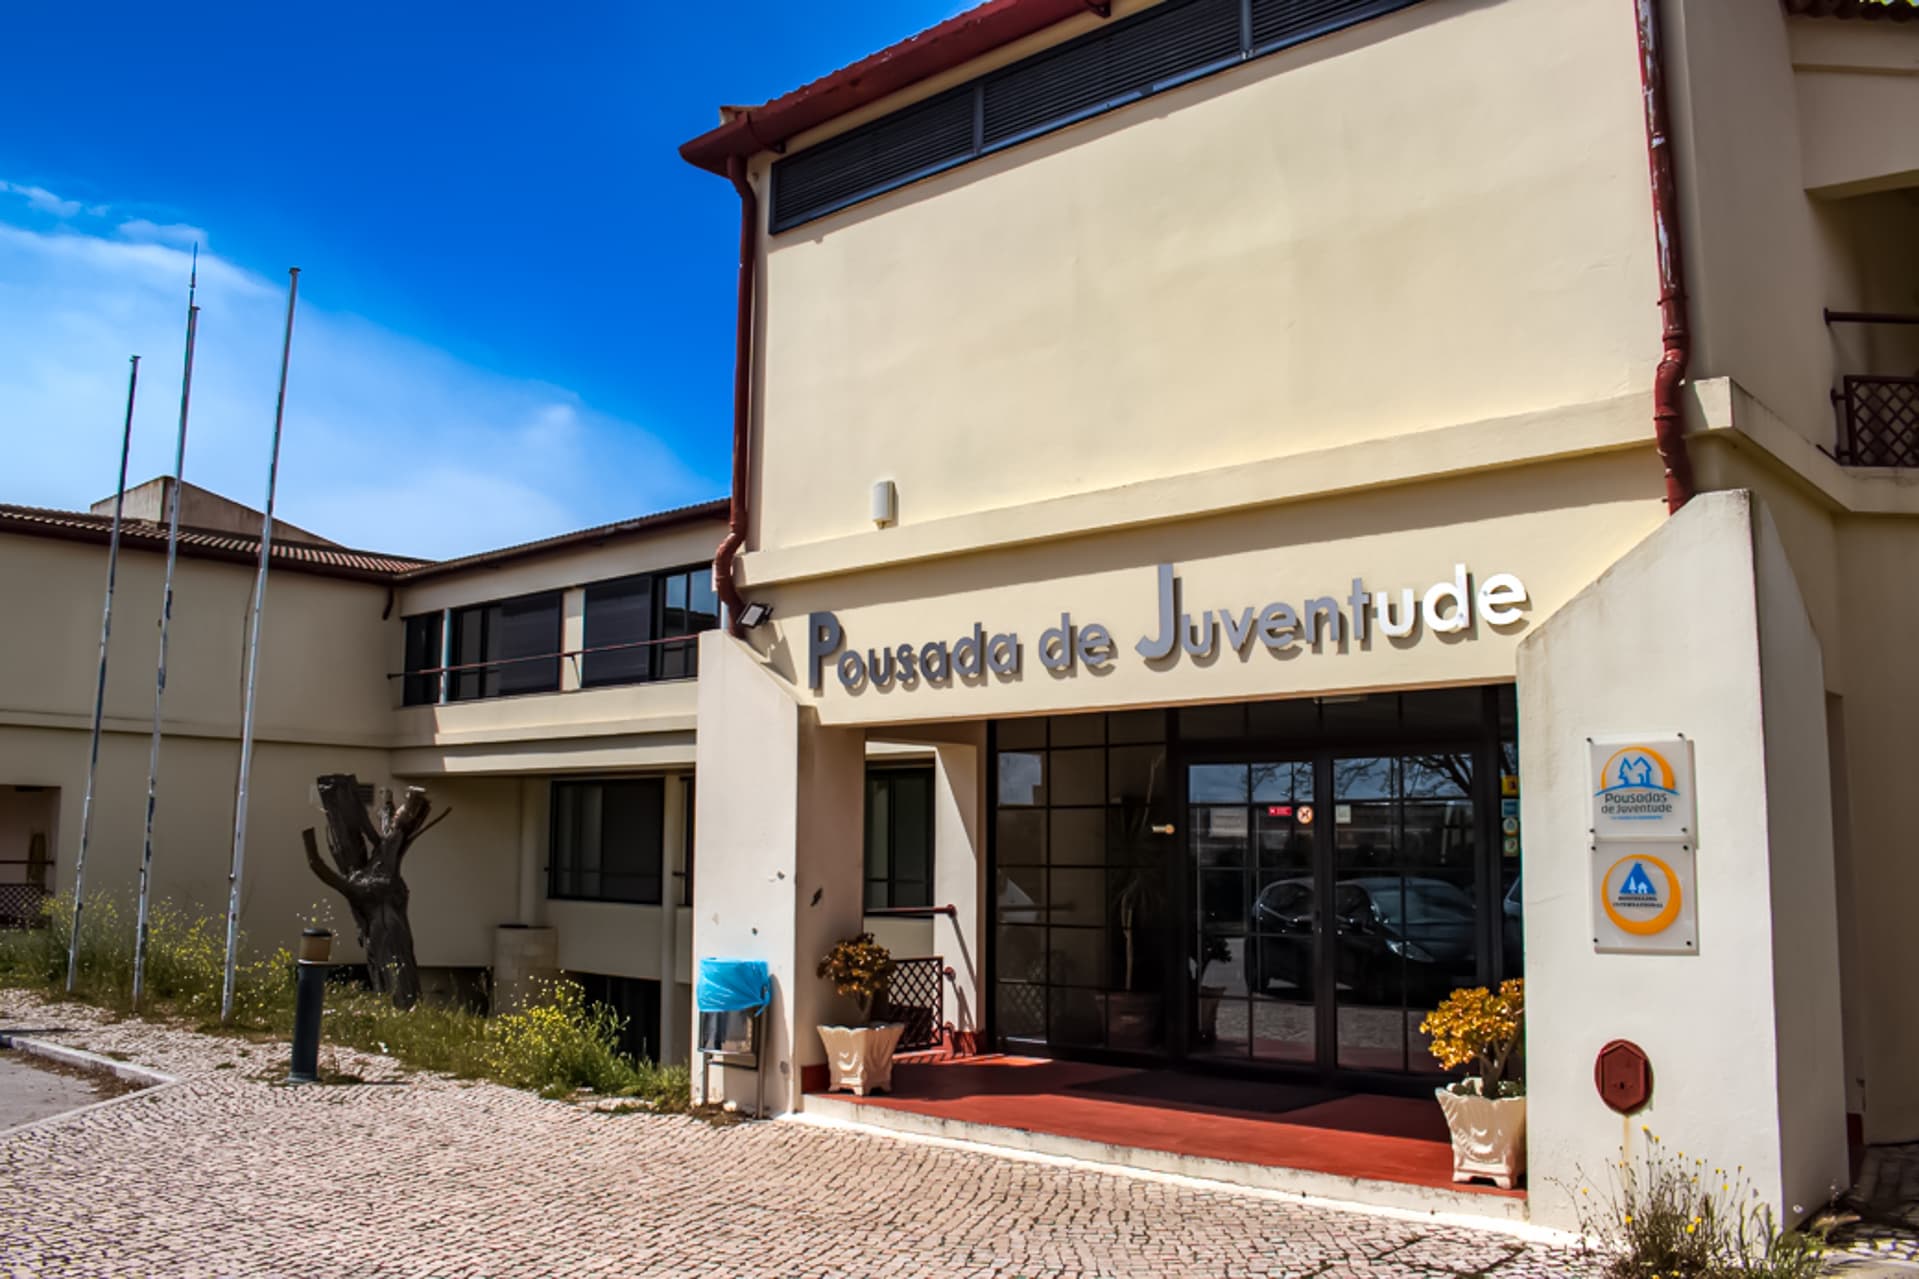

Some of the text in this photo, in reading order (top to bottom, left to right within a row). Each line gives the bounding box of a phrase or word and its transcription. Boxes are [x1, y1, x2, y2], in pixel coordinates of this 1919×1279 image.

[809, 563, 1527, 689] Pousada de Juventude
[1604, 792, 1668, 804] Pousadas
[1600, 803, 1673, 814] de Juventude
